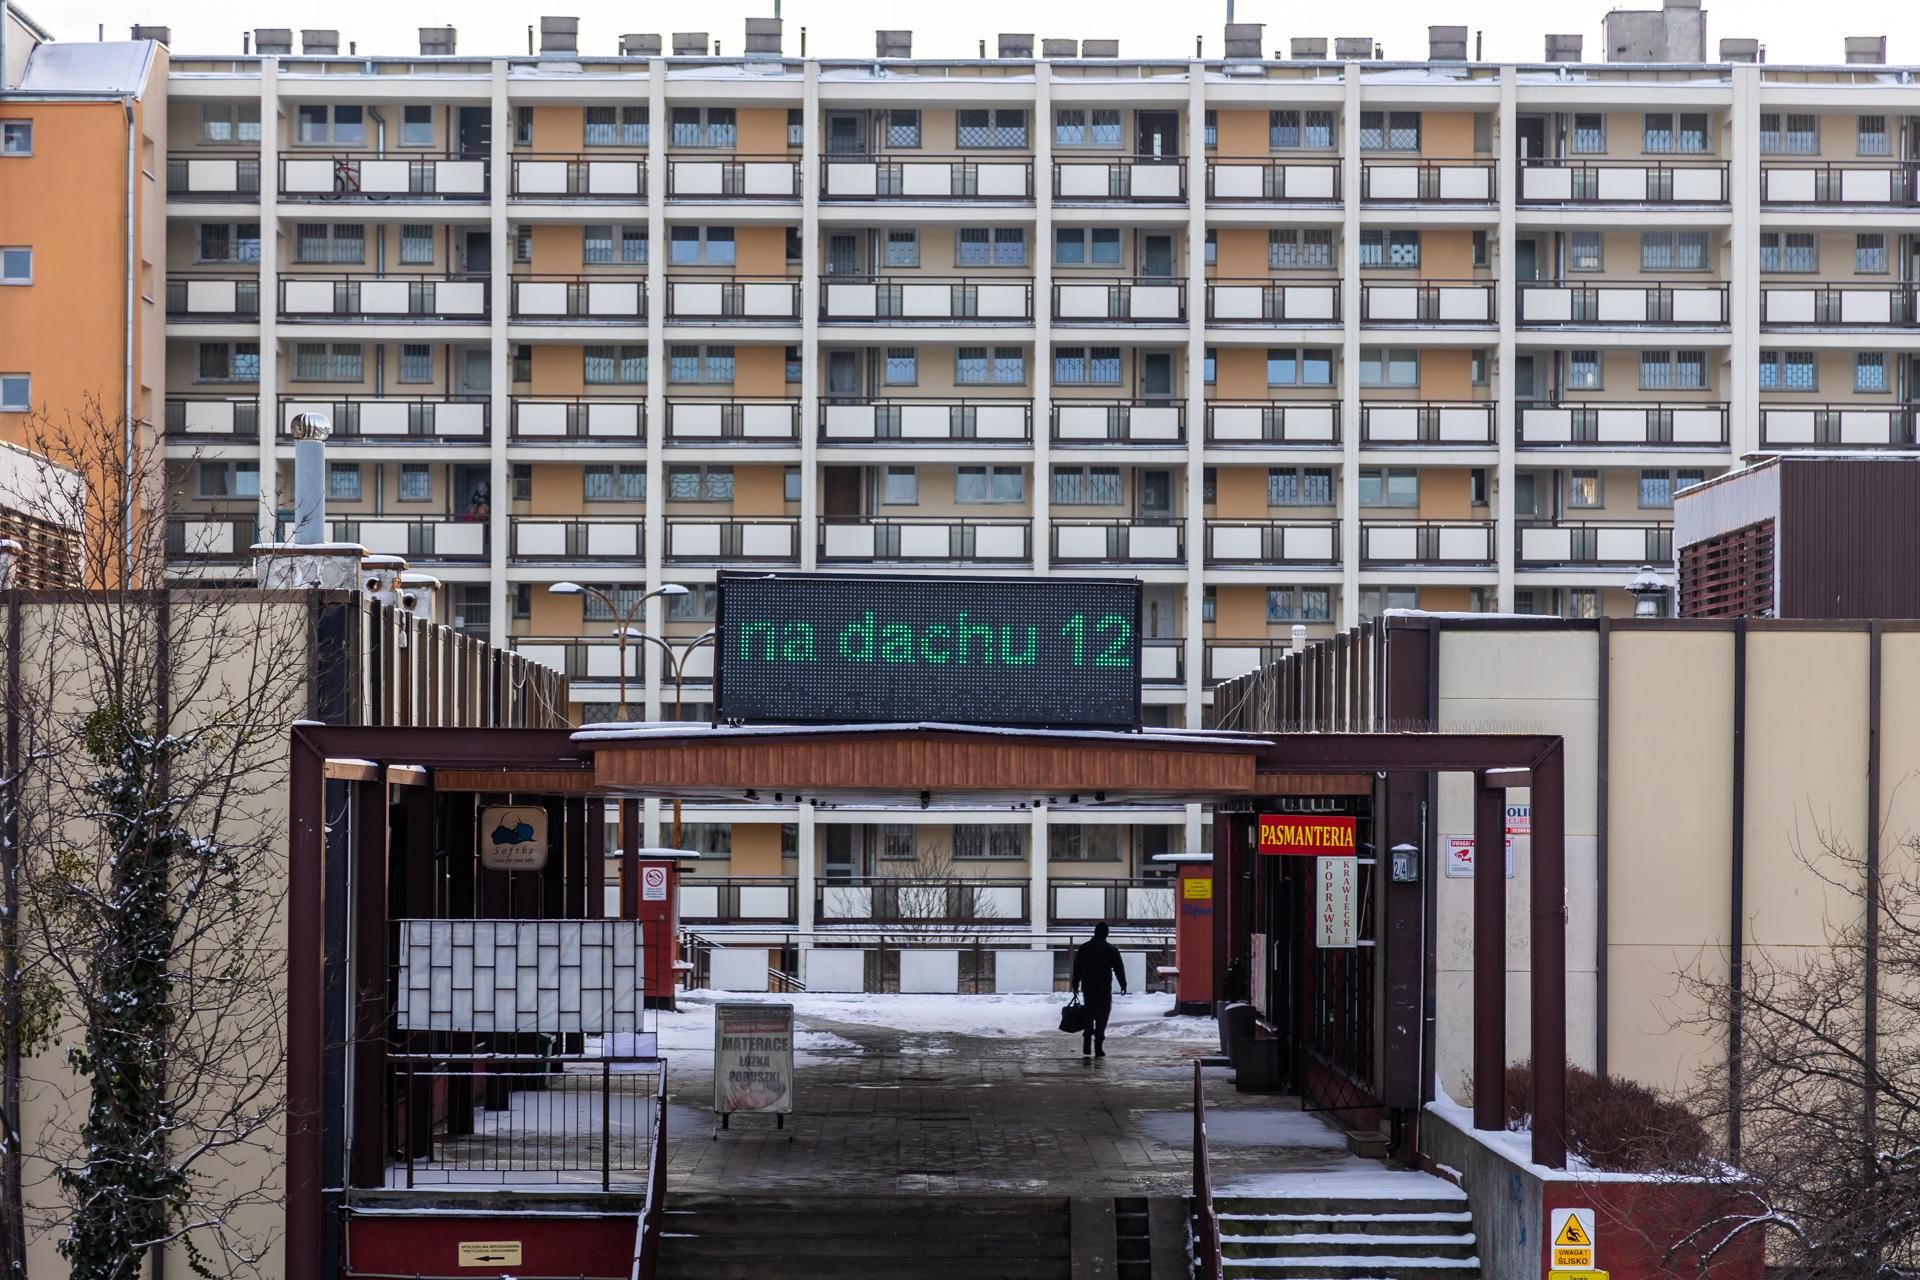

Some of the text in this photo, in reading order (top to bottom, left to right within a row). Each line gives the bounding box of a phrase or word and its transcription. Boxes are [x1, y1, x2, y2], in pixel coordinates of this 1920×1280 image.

[740, 610, 1131, 667] na dachu 12
[1260, 824, 1354, 848] PASMANTERIA
[1323, 860, 1335, 945] POPRAWKI
[1341, 860, 1352, 945] KRAWIECKIE
[721, 1036, 789, 1052] MATERACE
[729, 1071, 780, 1083] PODUSZKI
[1558, 1256, 1588, 1265] ŚLISKO
